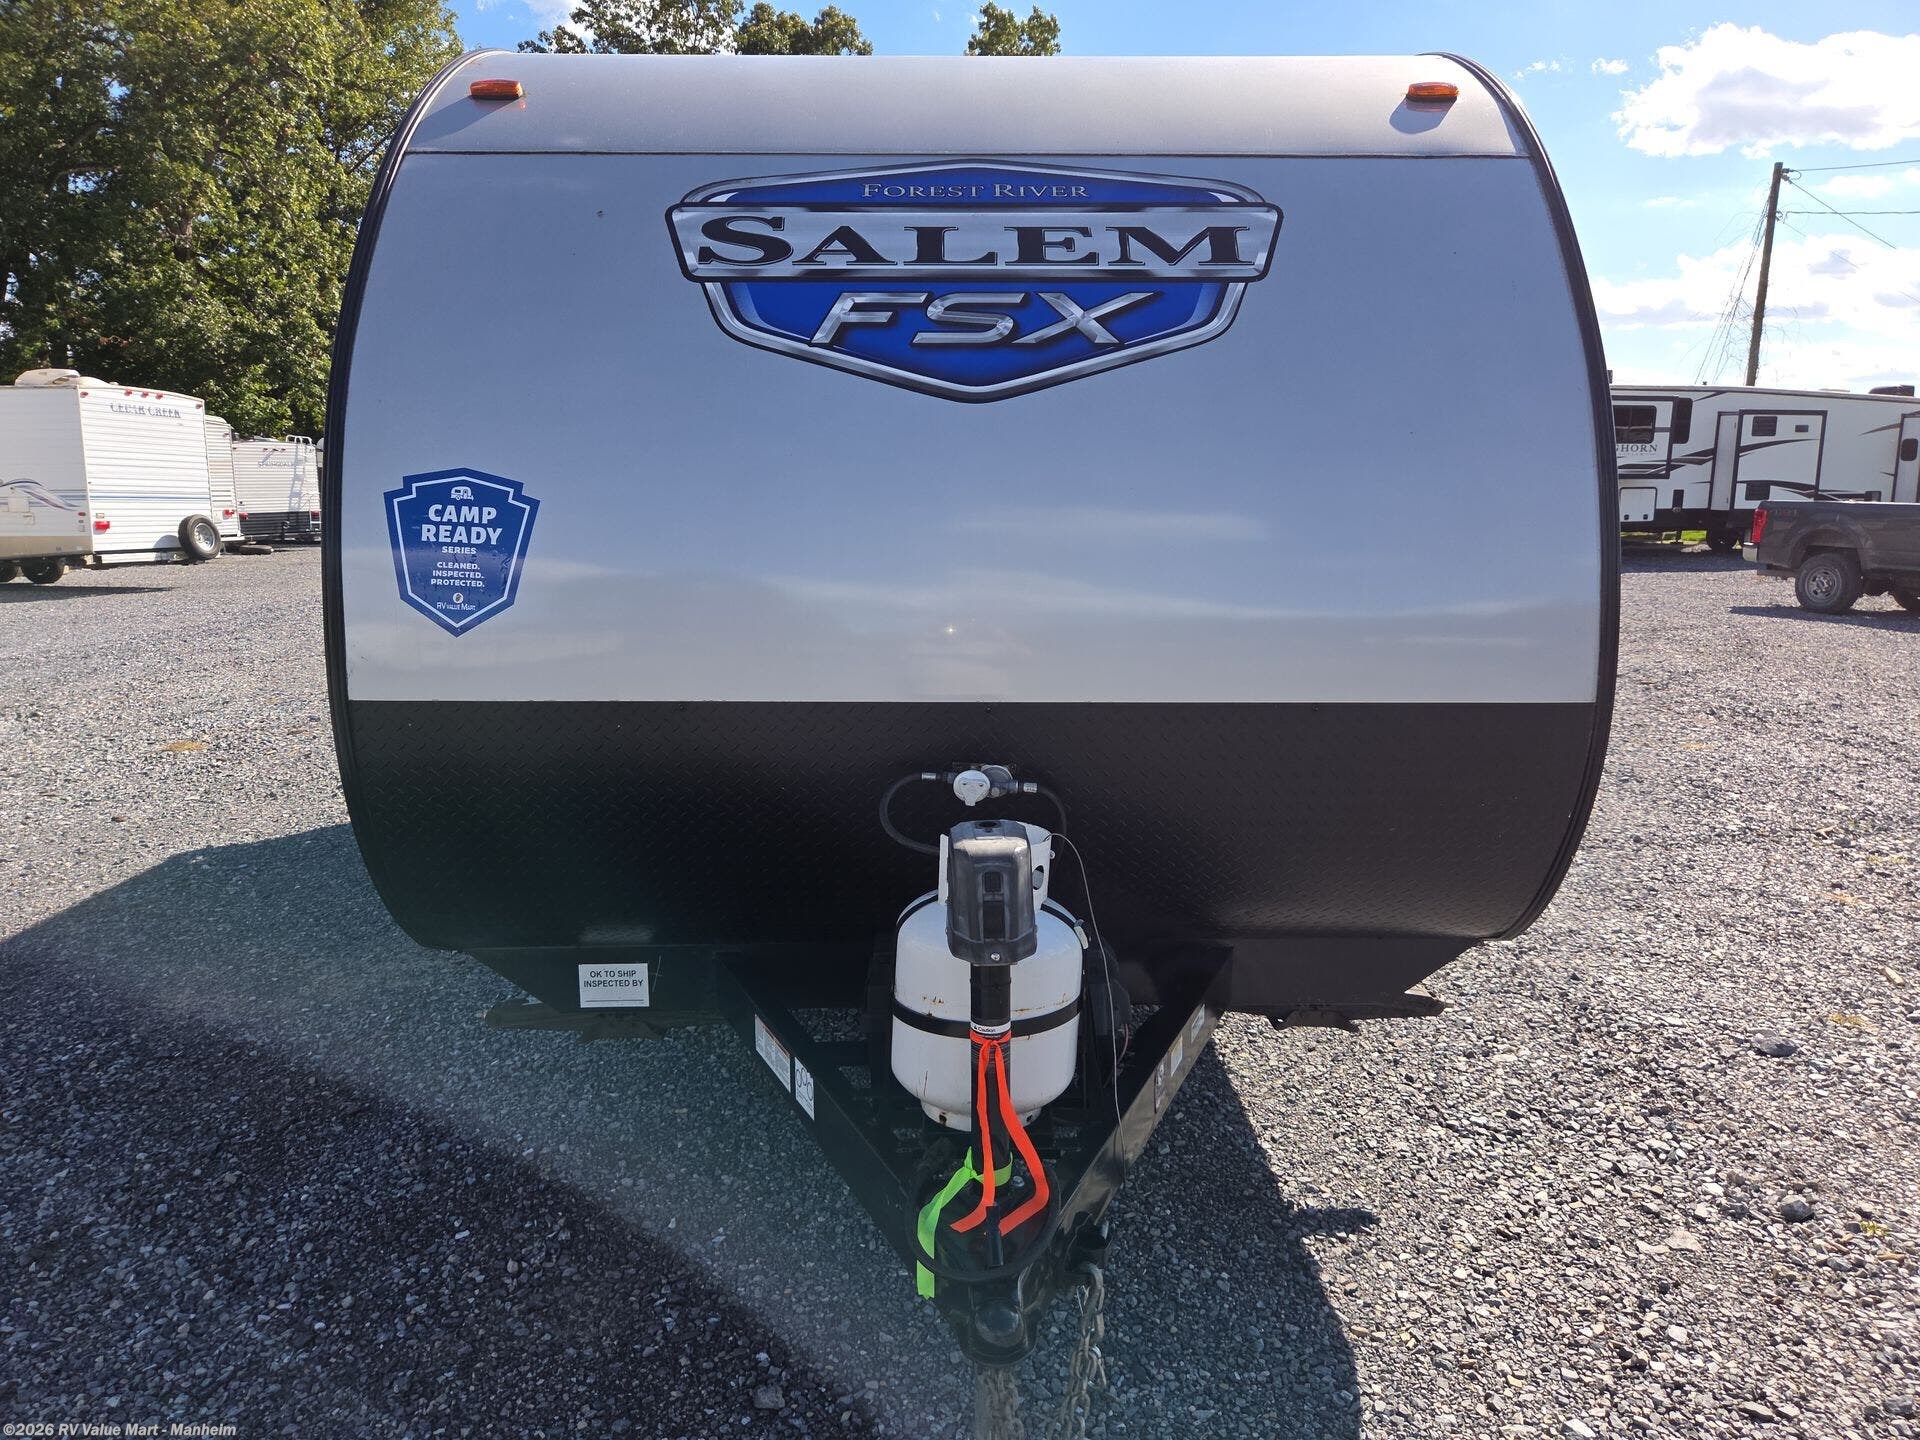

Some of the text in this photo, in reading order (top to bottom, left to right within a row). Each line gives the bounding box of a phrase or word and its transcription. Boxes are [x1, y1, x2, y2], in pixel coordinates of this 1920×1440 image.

[863, 183, 1089, 198] FOREST RIVER
[698, 215, 1254, 267] SALEM
[810, 291, 1155, 345] FSX
[428, 504, 497, 524] CAMP
[422, 524, 502, 545] READY
[441, 546, 476, 555] SERIES
[437, 562, 480, 570] CLEANED.
[432, 570, 484, 579] INSPECTED.
[430, 579, 485, 587] PROTECTED.
